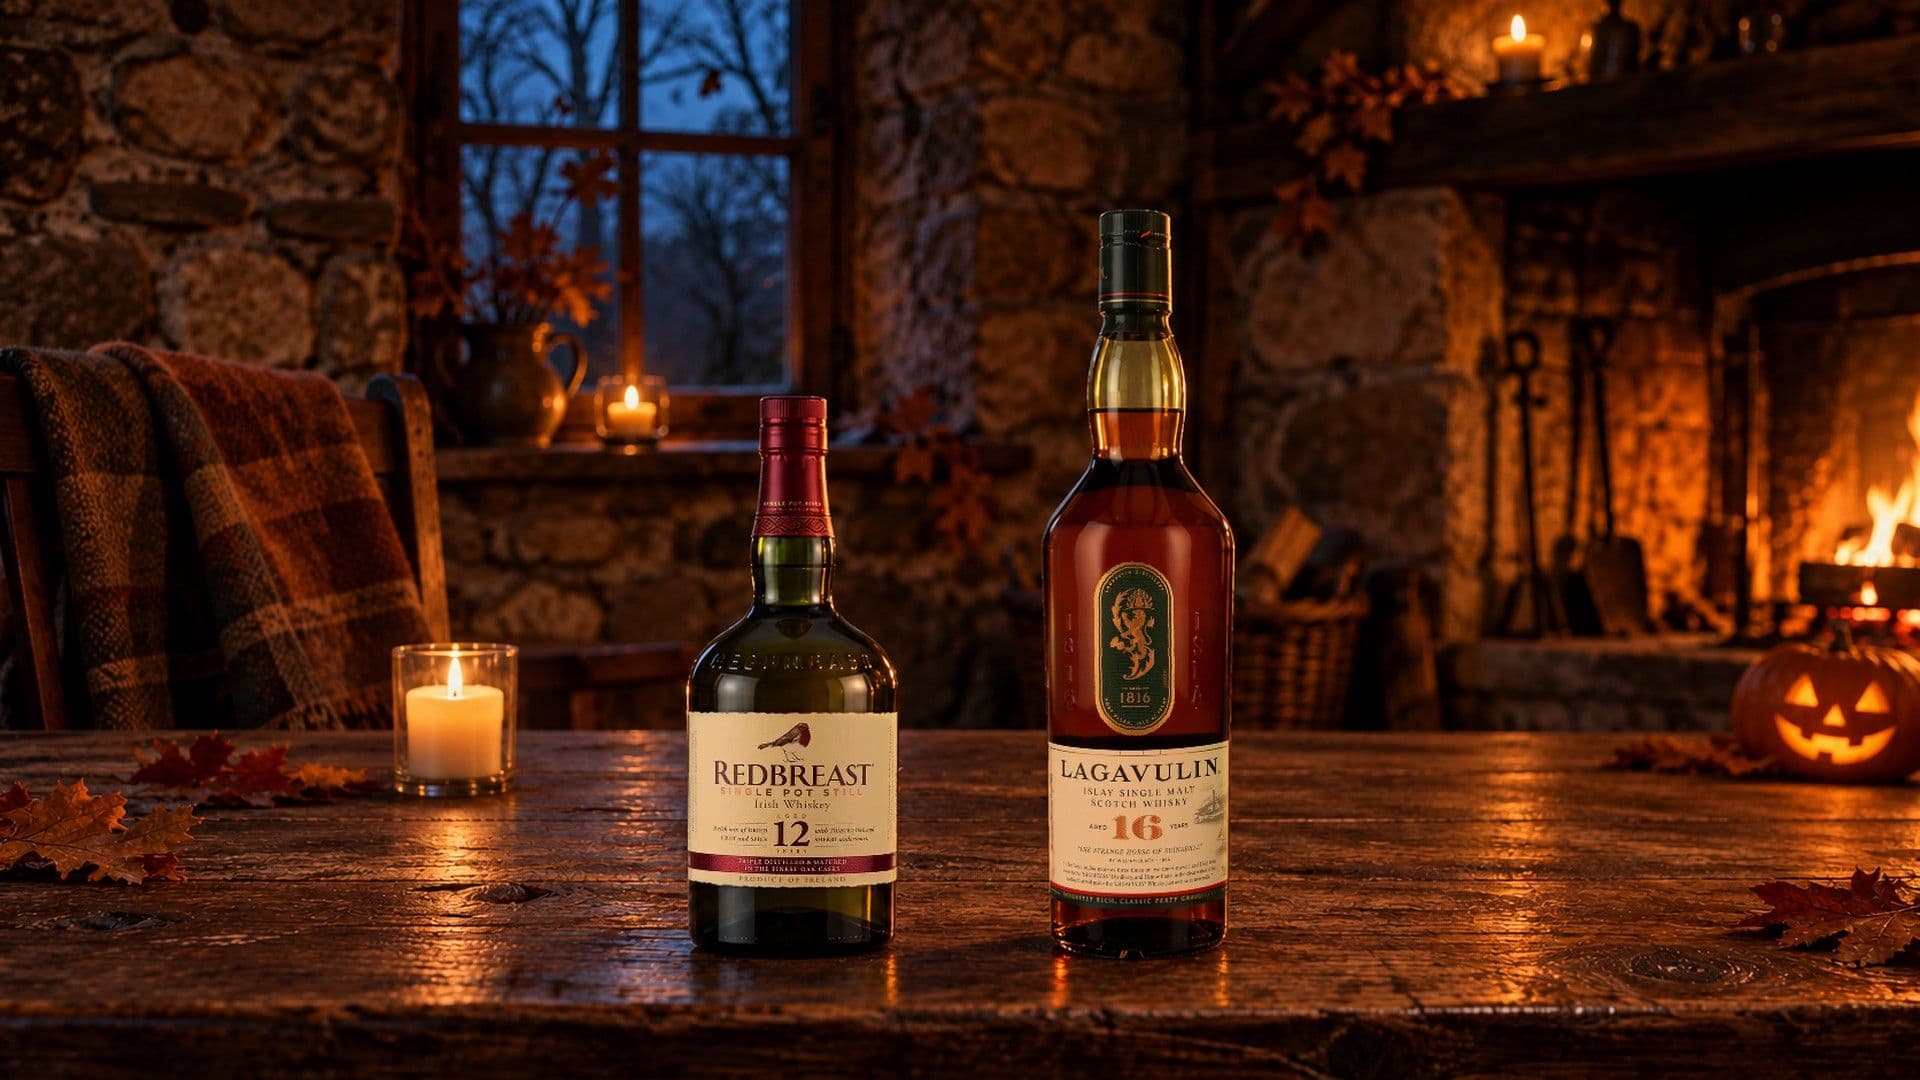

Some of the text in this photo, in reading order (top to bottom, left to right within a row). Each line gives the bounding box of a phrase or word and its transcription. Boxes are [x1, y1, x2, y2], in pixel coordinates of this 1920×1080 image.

[1120, 692, 1151, 703] 1816
[714, 760, 872, 787] REDBREAST
[1061, 757, 1218, 782] LAGAVULIN
[720, 788, 863, 797] SINGLE POT STILL
[1083, 786, 1195, 798] ISLAY SINGLE MALT
[754, 799, 831, 812] Irish Whiskey
[1090, 798, 1187, 809] SCOTCH WHISKY
[773, 820, 810, 847] 12
[1089, 823, 1108, 831] AGED
[1112, 814, 1163, 841] 16
[1152, 847, 1163, 855] OF
[739, 875, 782, 883] PRODUCT
[804, 875, 846, 883] IRELAND
